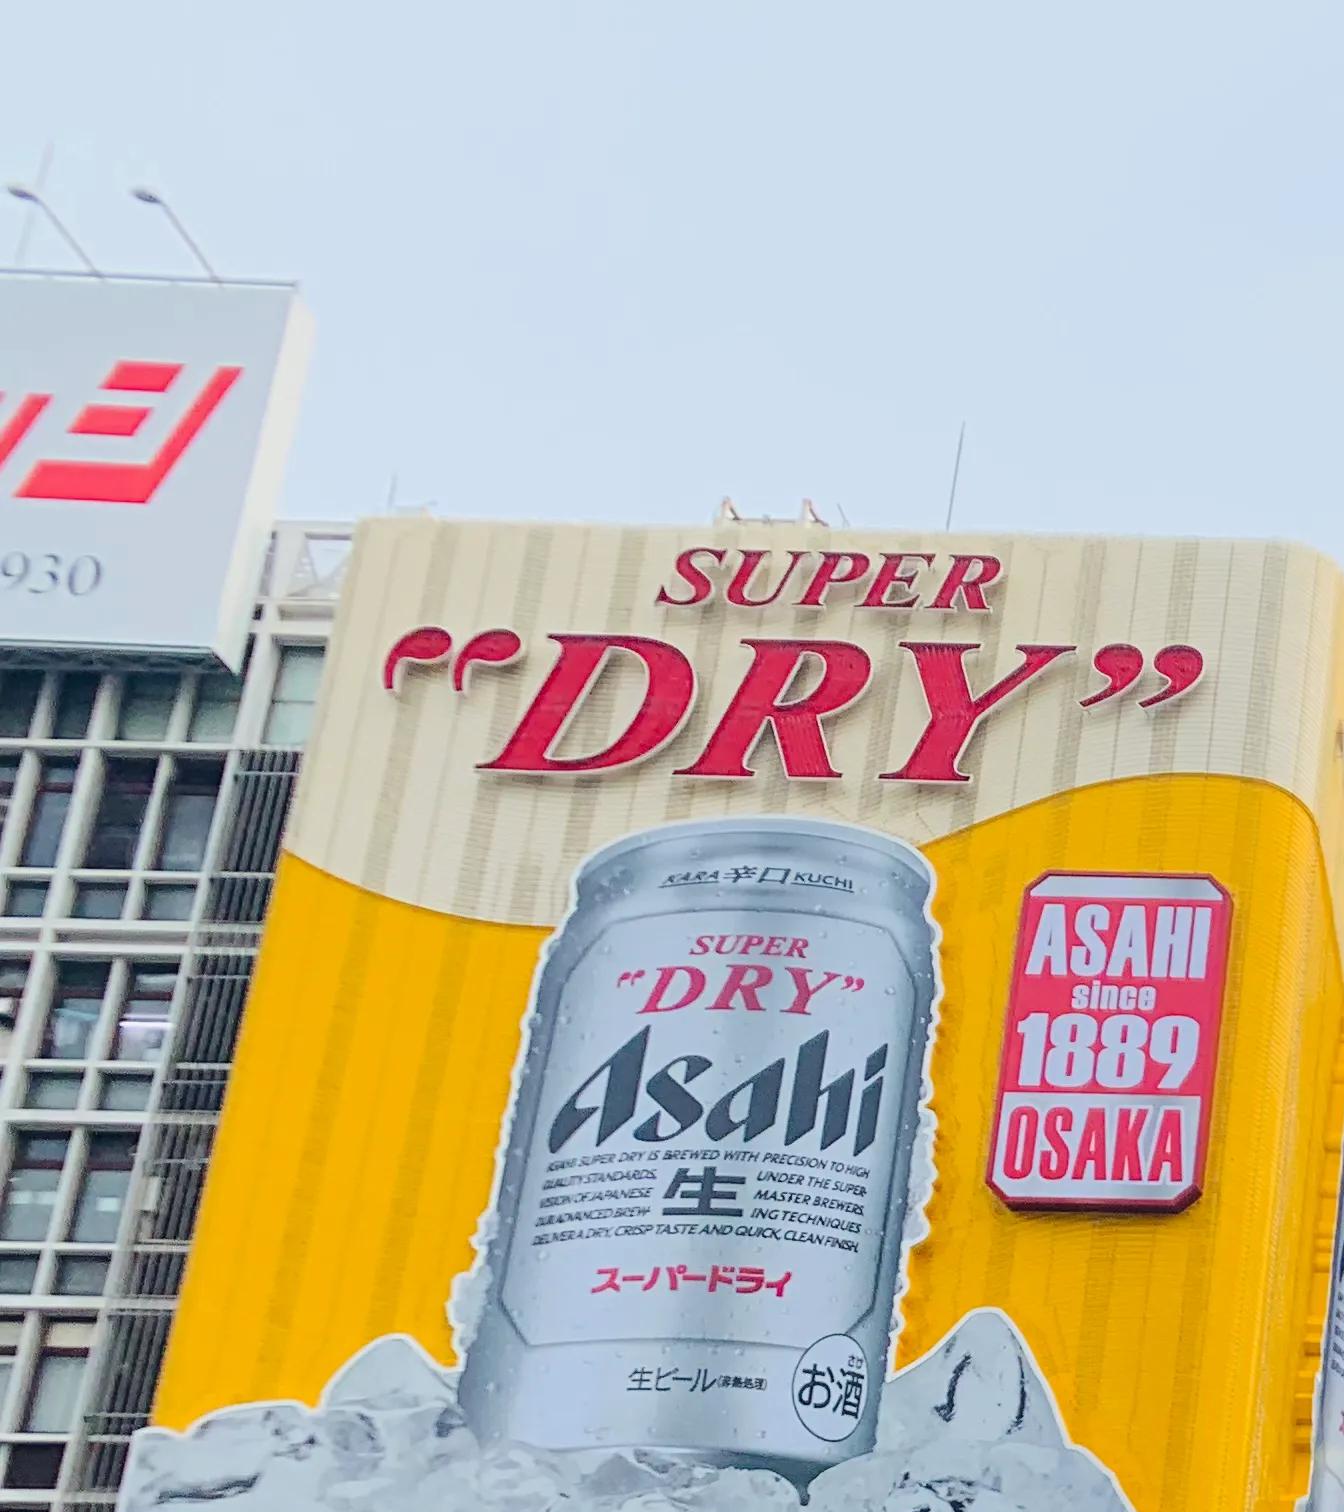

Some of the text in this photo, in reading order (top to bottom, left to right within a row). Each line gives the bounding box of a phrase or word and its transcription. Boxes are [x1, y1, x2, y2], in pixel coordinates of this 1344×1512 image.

[657, 547, 1002, 613] SUPER
[723, 866, 791, 884] 辛口
[793, 871, 854, 890] KUCHI
[689, 934, 809, 959] SUPER
[1024, 903, 1213, 979] ASAHI
[1071, 979, 1157, 1013] since
[1016, 1011, 1201, 1091] 1889
[547, 1024, 889, 1158] Asahi
[1002, 1106, 1186, 1184] OSAKA
[578, 1153, 616, 1167] SUPER
[618, 1151, 645, 1163] DRY
[648, 1150, 661, 1161] IS
[662, 1150, 721, 1161] BREWED
[724, 1150, 760, 1162] WITH
[762, 1152, 829, 1170] PRECISION
[830, 1161, 845, 1174] TO
[846, 1165, 871, 1180] HIGH
[757, 1170, 805, 1186] UNDER
[807, 1176, 832, 1190] THE
[588, 1187, 655, 1203] JAPANESE
[662, 1166, 746, 1219] 生
[753, 1190, 811, 1206] MASTER
[614, 1225, 652, 1237] CRISP
[655, 1224, 699, 1236] TASTE
[700, 1223, 733, 1236] AND
[784, 1230, 825, 1246] CLEAN
[750, 1208, 862, 1234] ING TECHNIQUES
[591, 1264, 793, 1298] スーパードライ
[797, 1363, 865, 1420] お酒
